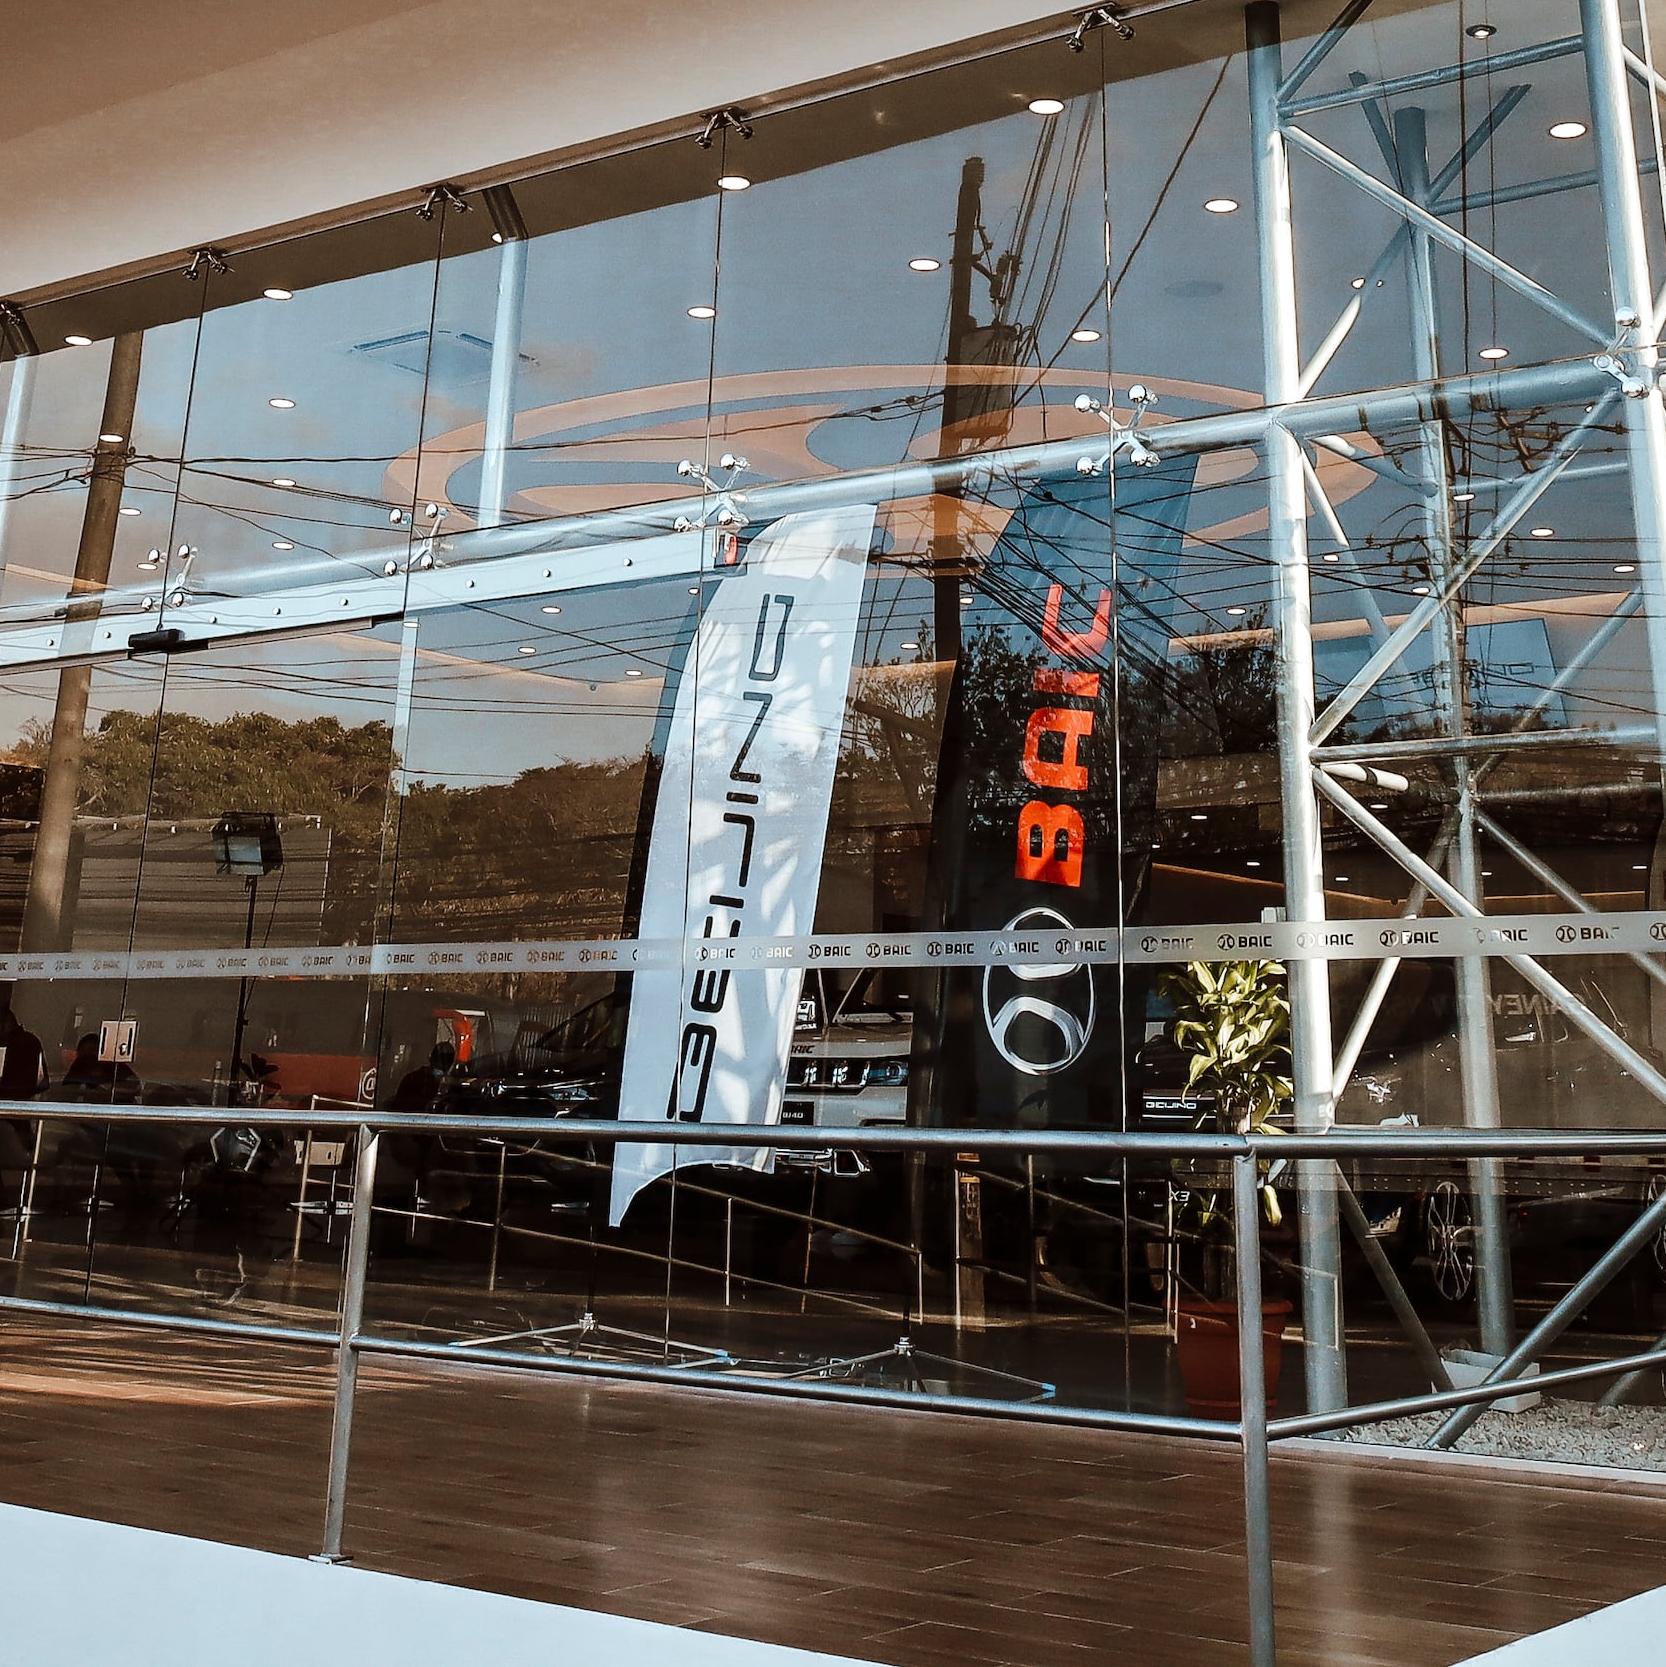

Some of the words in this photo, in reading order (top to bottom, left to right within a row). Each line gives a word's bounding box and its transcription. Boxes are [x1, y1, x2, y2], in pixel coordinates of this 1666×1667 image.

[1015, 584, 1112, 888] BAIC
[1161, 937, 1194, 949] BAIC
[1238, 935, 1273, 948] BAIC
[766, 946, 793, 958] BAIC
[823, 946, 851, 956] BAIC
[883, 945, 911, 956] BAIC
[945, 943, 975, 955] BAIC
[227, 958, 247, 967] BAIC
[270, 957, 289, 966] BAIC
[313, 956, 333, 965] BAIC
[393, 954, 415, 964] BAIC
[441, 953, 463, 964] BAIC
[490, 952, 513, 962] BAIC
[541, 951, 565, 962] BAIC
[593, 951, 618, 961] BAIC
[1171, 1190, 1190, 1202] X3
